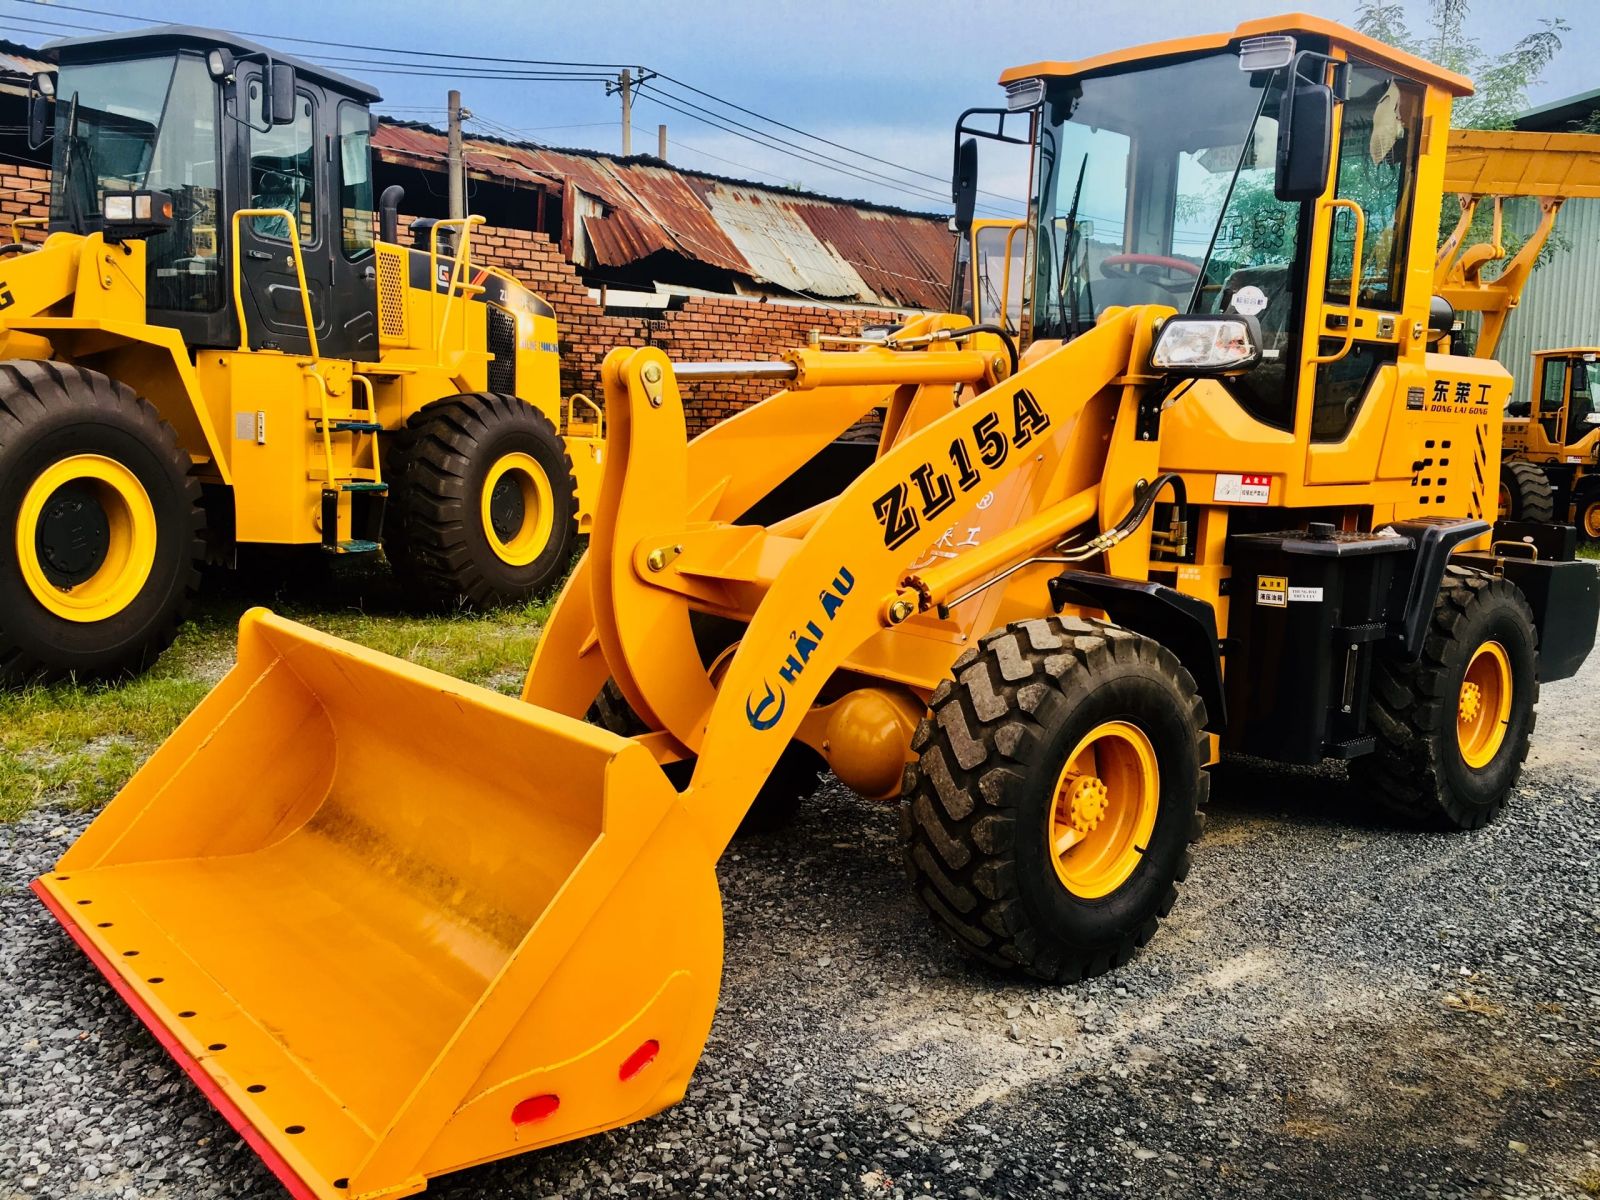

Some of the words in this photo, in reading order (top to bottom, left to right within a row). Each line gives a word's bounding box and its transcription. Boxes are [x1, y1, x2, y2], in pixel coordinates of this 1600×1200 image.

[1431, 404, 1452, 413] DONG
[1454, 406, 1467, 414] LAI
[872, 388, 1051, 551] ZL15A
[779, 620, 824, 686] HẢI
[819, 566, 855, 621] ÂU
